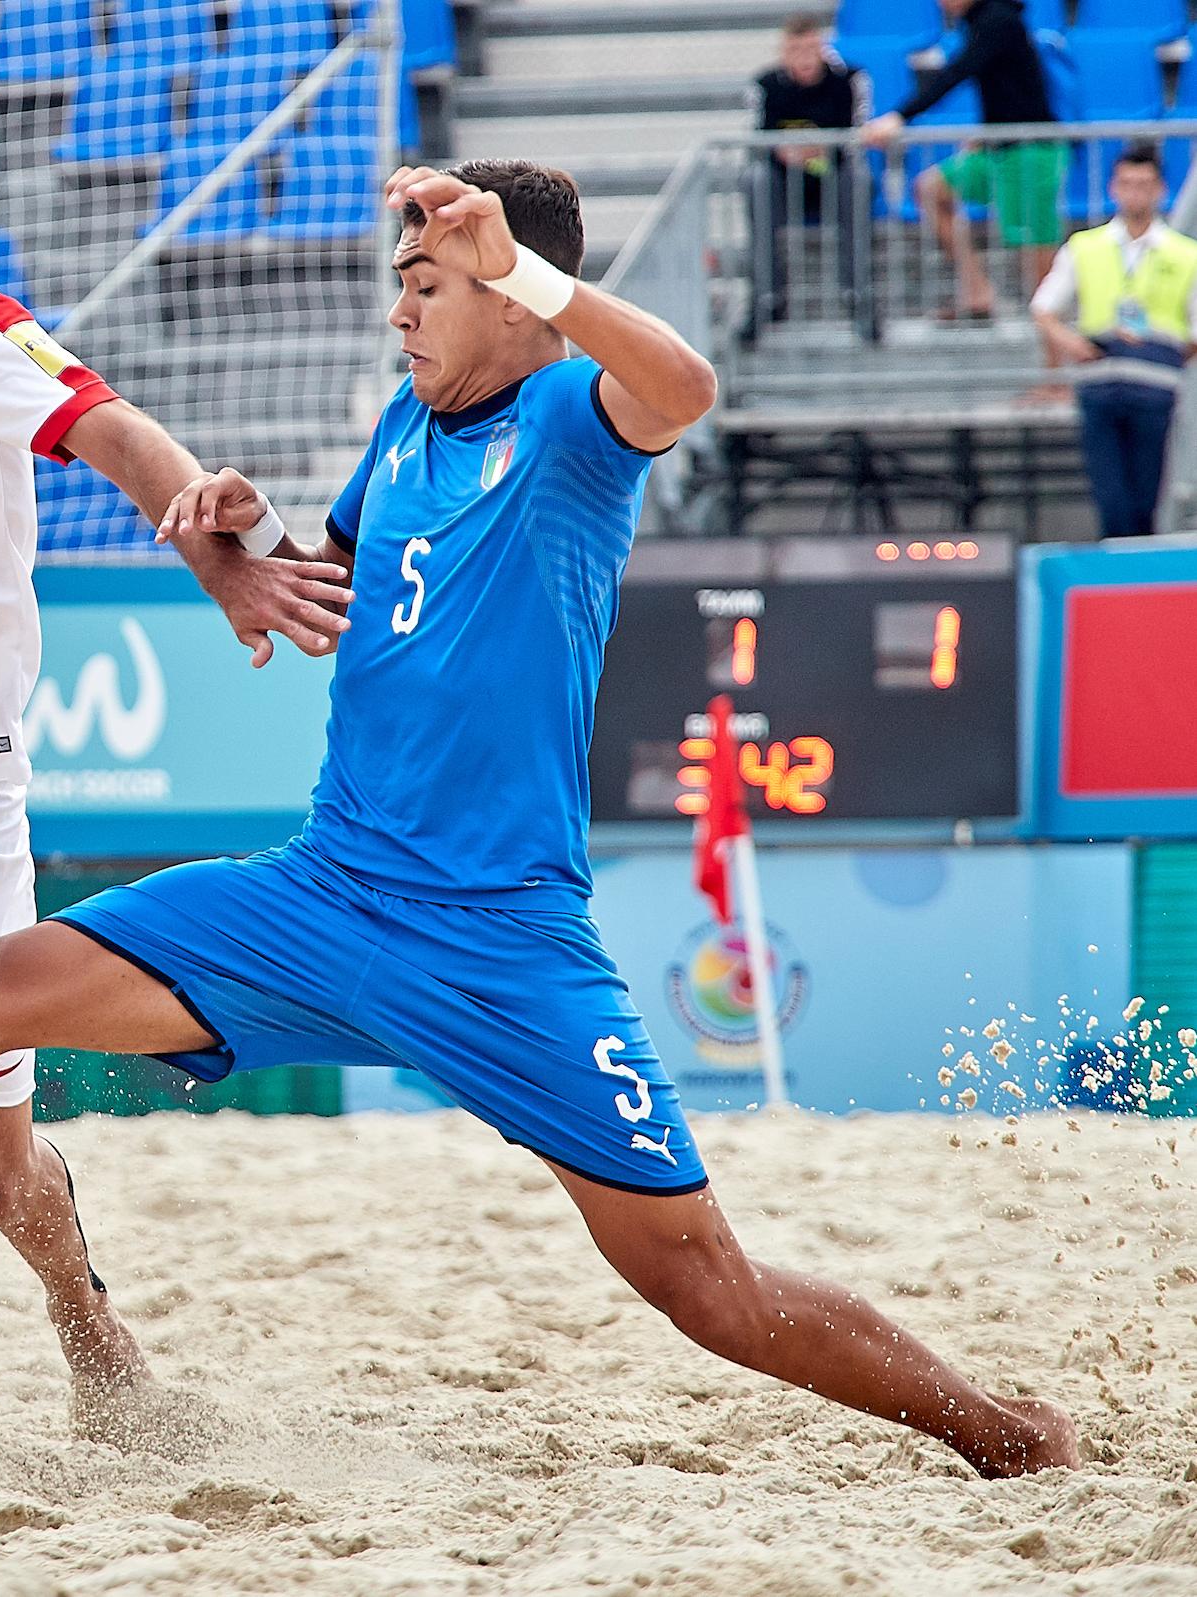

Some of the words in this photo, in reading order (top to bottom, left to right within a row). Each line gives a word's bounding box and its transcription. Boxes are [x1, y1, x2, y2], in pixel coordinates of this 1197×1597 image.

[391, 537, 432, 635] 5
[732, 618, 757, 686] 1
[930, 606, 961, 689] 1
[593, 1035, 653, 1123] 5
